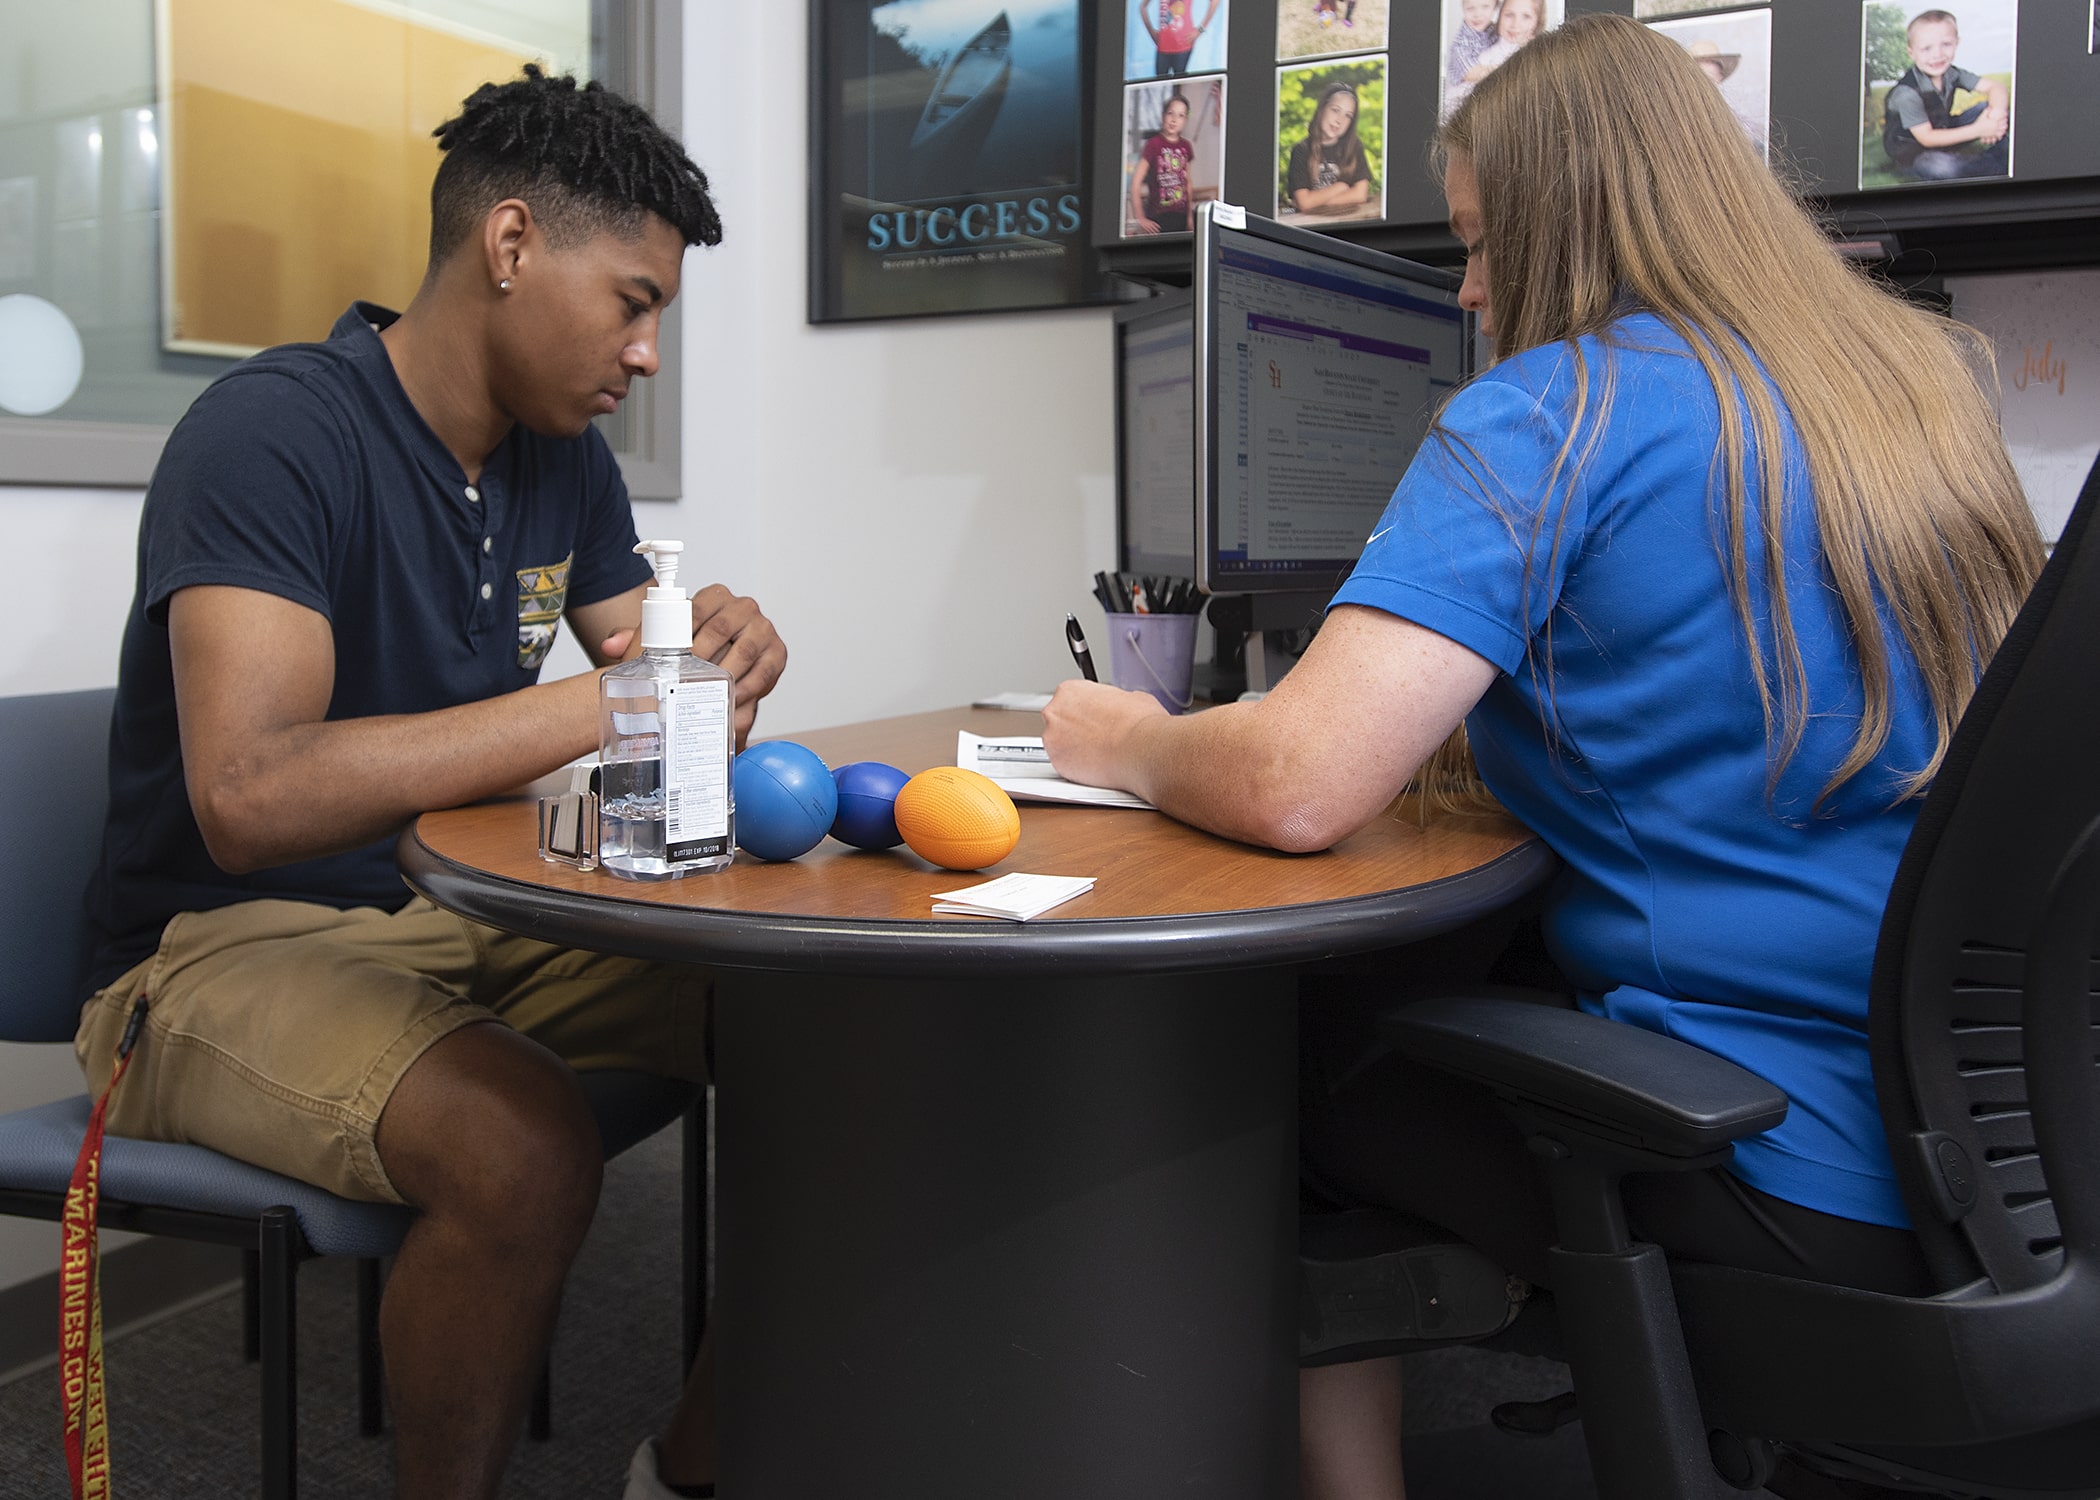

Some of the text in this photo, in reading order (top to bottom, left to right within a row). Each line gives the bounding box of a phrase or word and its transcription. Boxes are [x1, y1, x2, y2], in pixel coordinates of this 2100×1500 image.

[868, 194, 1081, 251] SUCCESS
[2013, 340, 2066, 395] July
[64, 1187, 87, 1434] MARINES.COM
